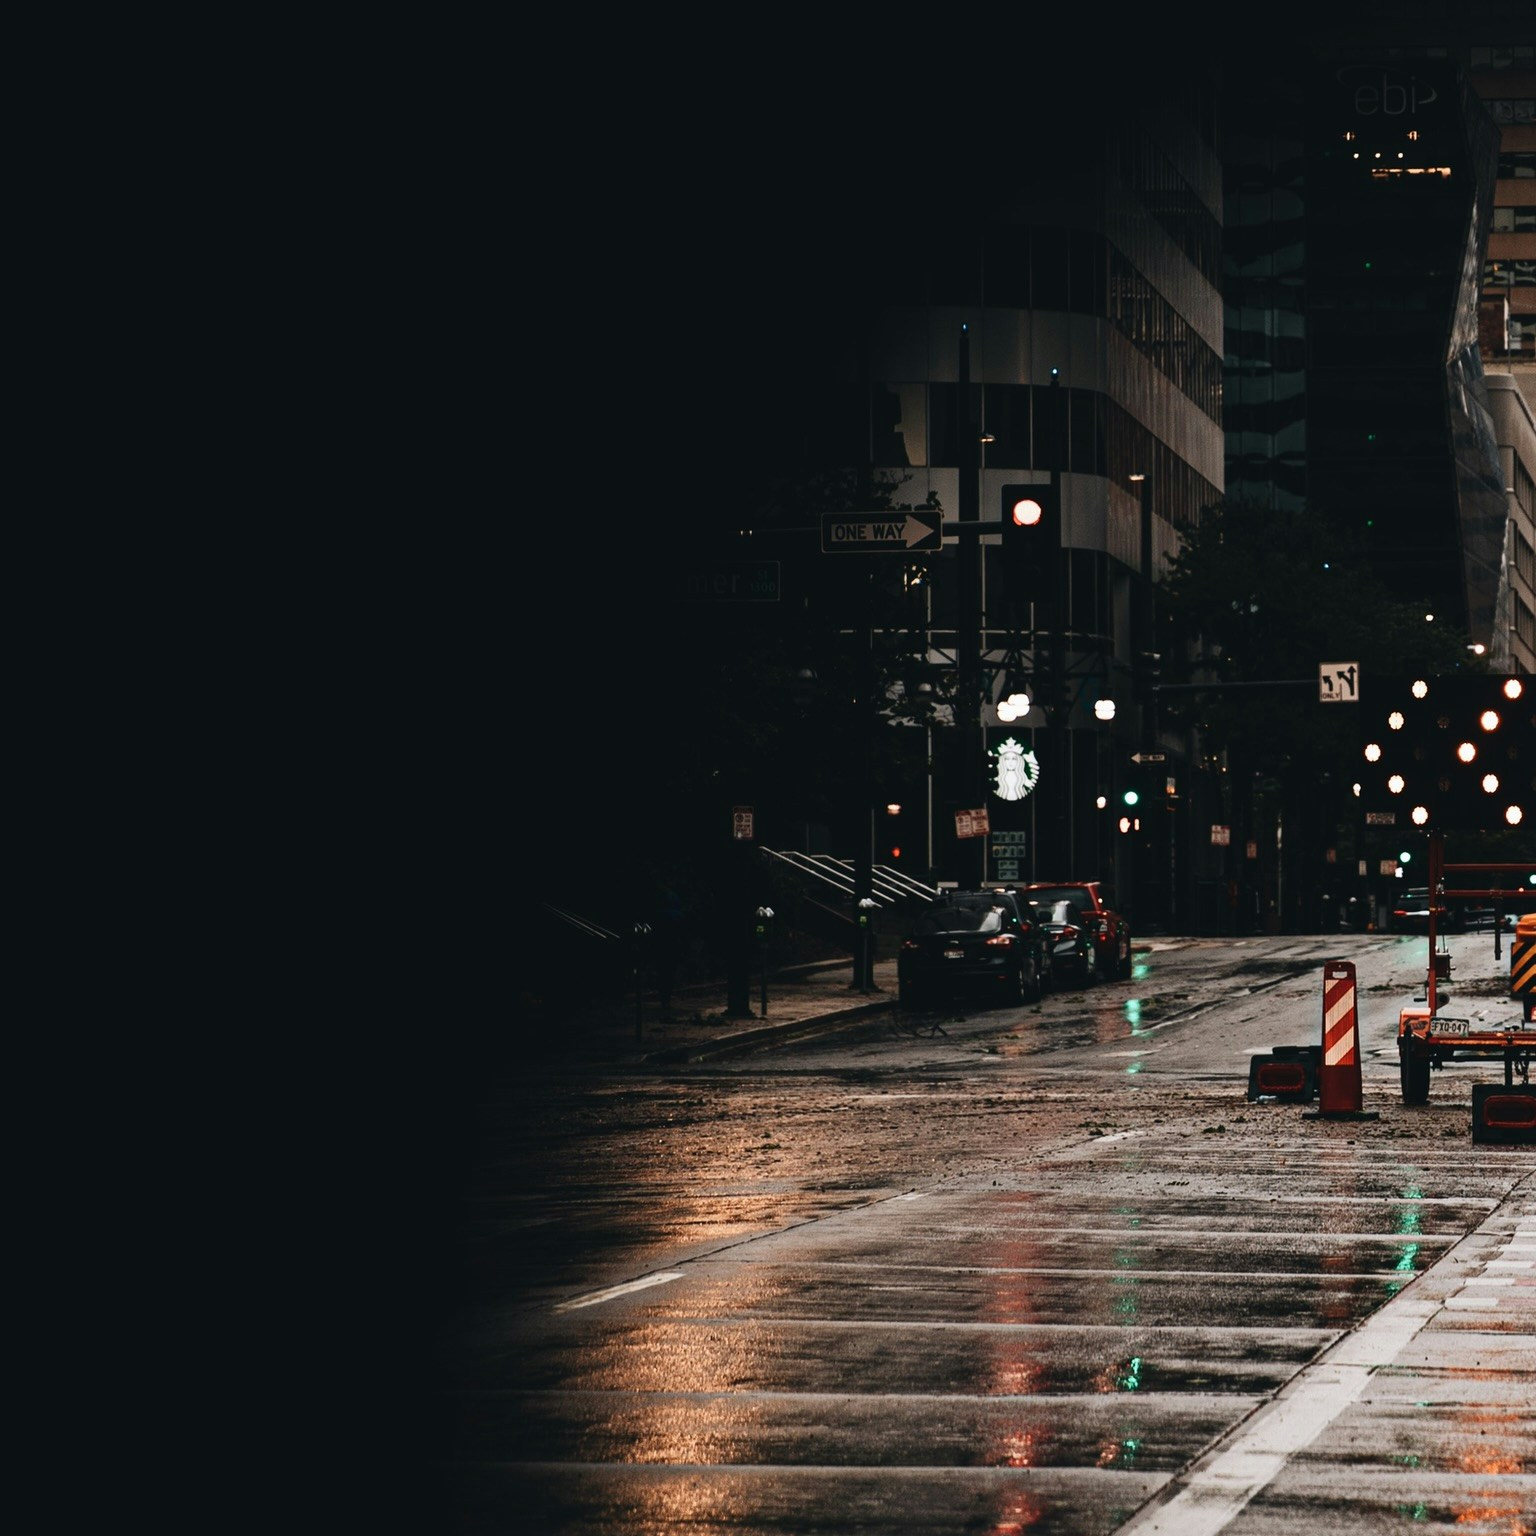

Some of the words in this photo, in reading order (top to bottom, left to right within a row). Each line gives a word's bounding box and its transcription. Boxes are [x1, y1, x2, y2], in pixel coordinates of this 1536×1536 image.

[1353, 71, 1416, 115] ebi
[835, 525, 867, 539] ONE
[873, 524, 905, 539] WAY
[750, 582, 776, 593] 1300
